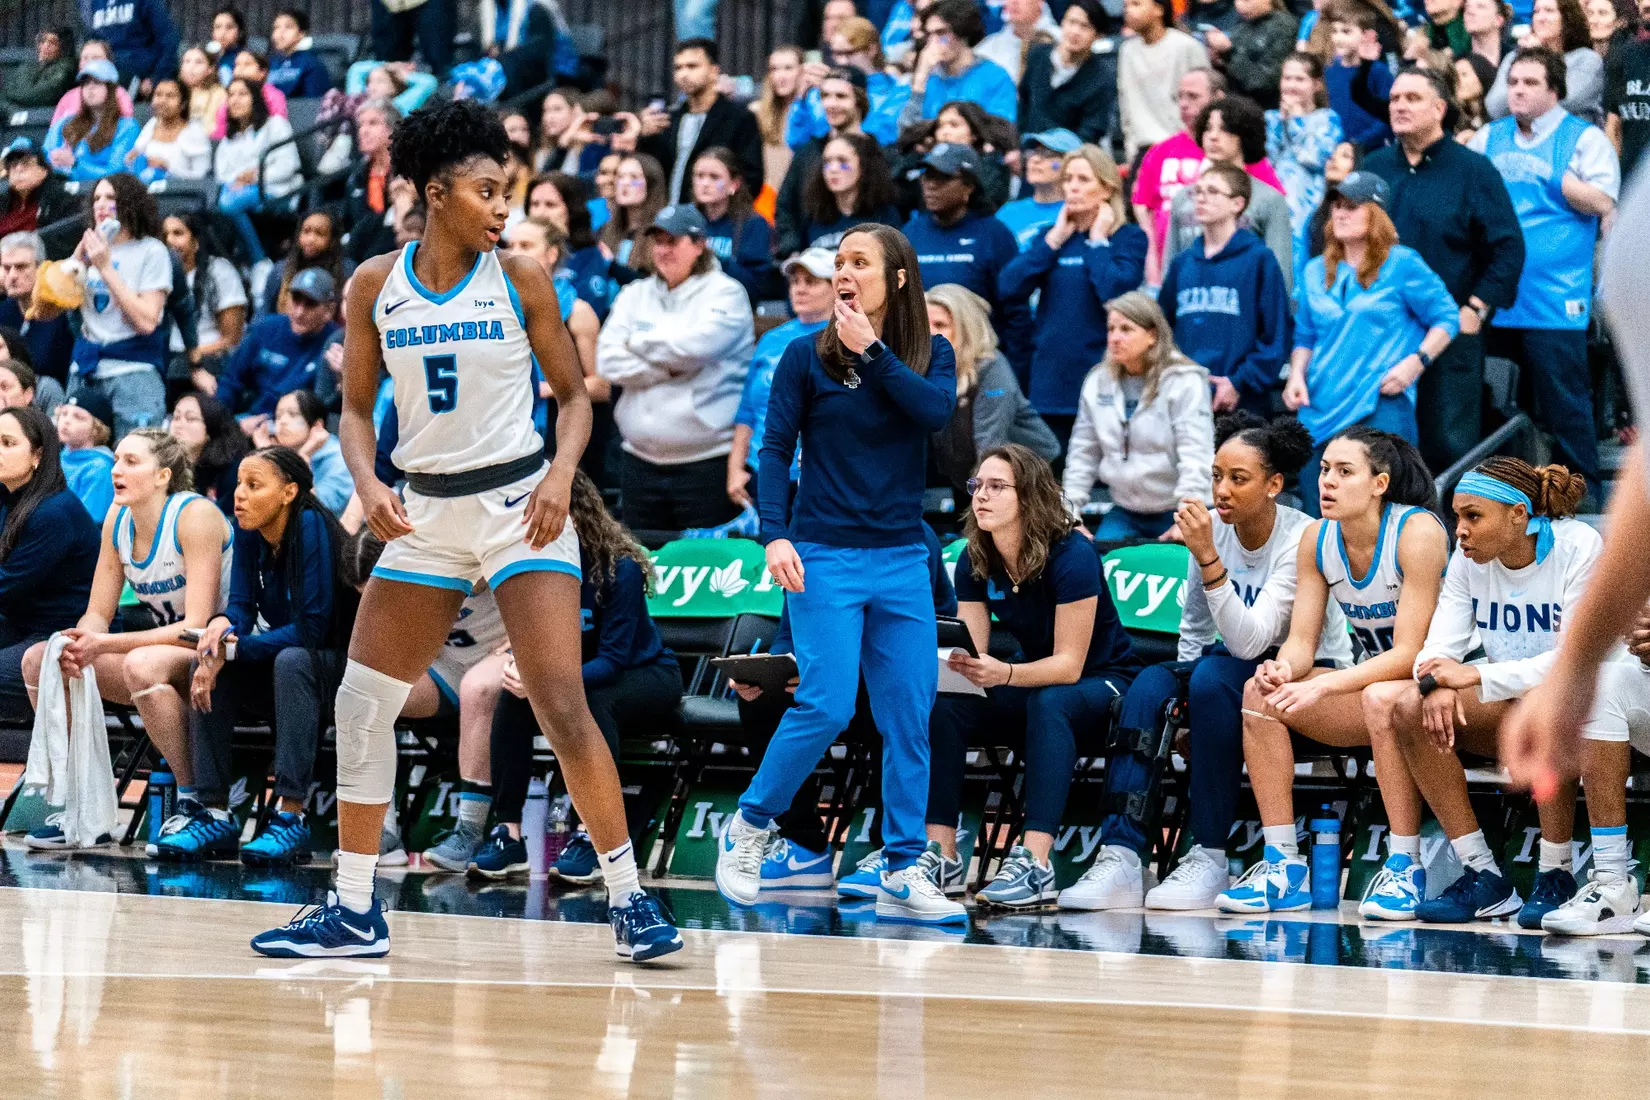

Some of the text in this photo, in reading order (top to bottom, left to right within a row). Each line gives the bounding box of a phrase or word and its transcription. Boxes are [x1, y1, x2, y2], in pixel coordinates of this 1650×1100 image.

[474, 299, 488, 309] Ivy
[386, 320, 505, 349] COLUMBIA
[422, 353, 459, 415] 5
[652, 556, 711, 607] vy
[1472, 597, 1562, 633] LIONS
[1053, 825, 1103, 863] vy
